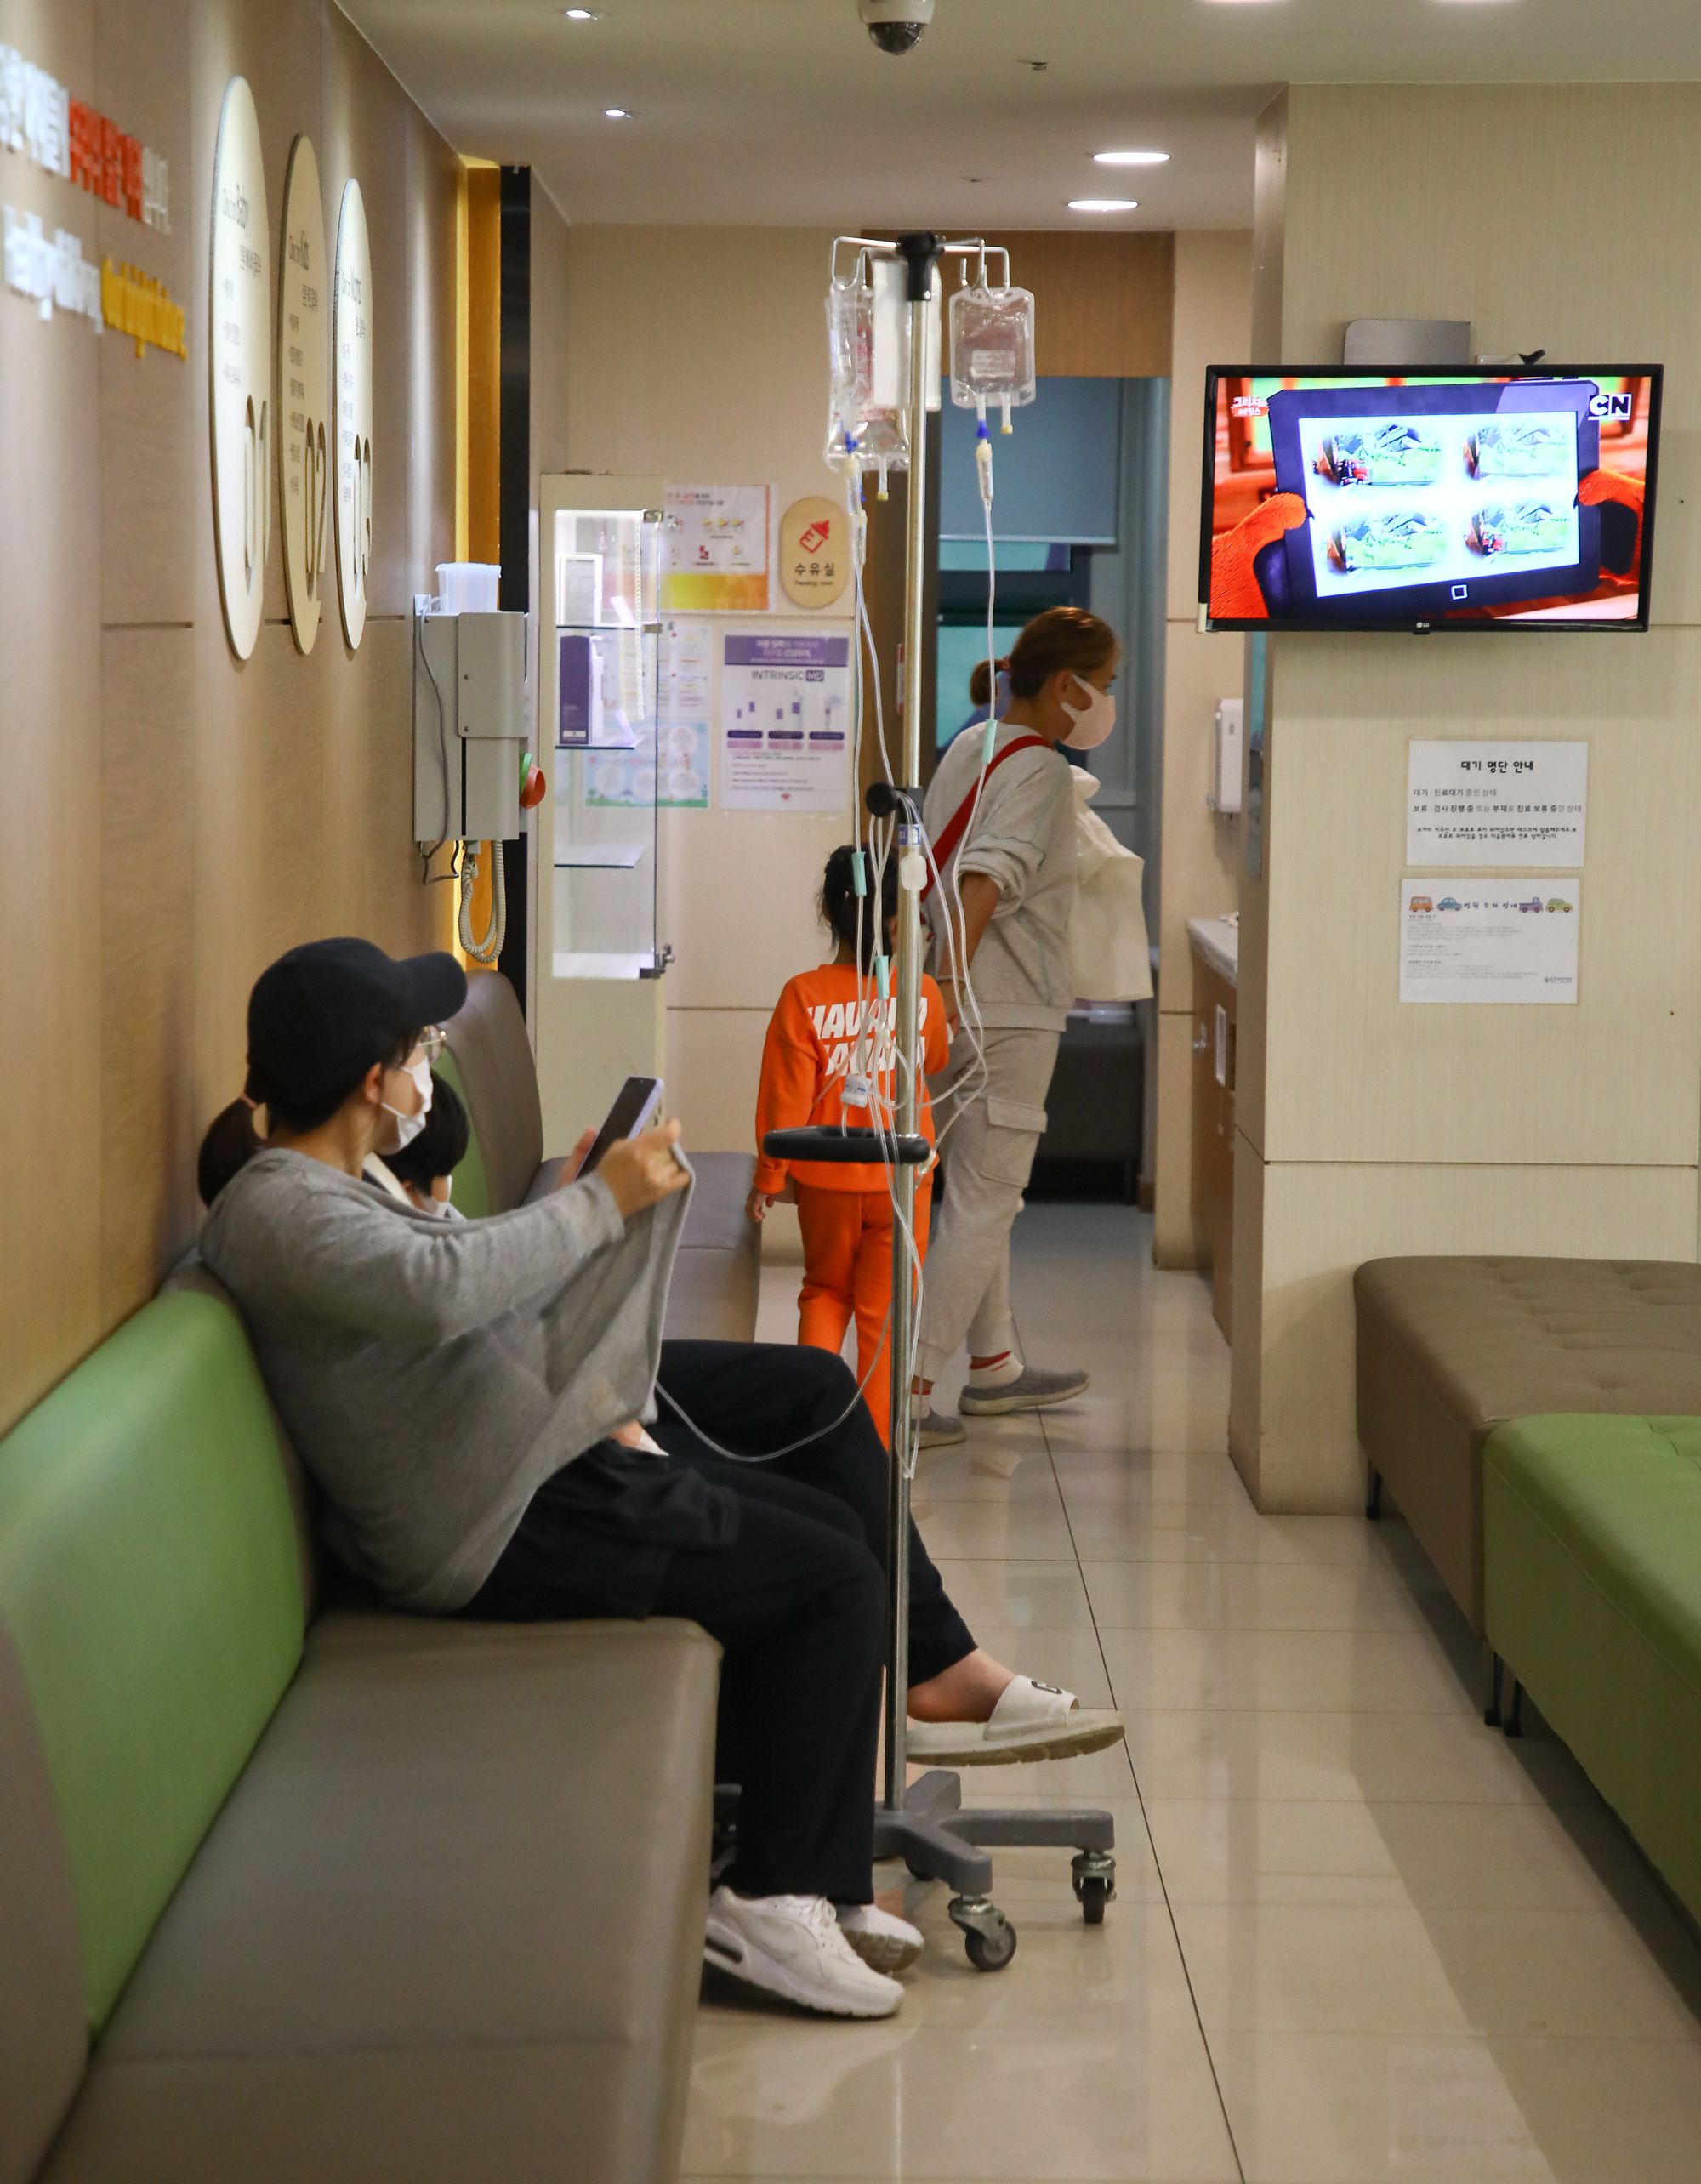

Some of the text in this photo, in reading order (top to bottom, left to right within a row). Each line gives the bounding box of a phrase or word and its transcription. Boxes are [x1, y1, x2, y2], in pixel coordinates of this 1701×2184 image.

[1589, 394, 1632, 416] CN
[794, 562, 835, 577] 수유실
[1461, 761, 1534, 773] 대기 명단 안내
[1414, 788, 1428, 797] 대기
[1434, 805, 1448, 813] 검사
[1533, 805, 1548, 813] 보류
